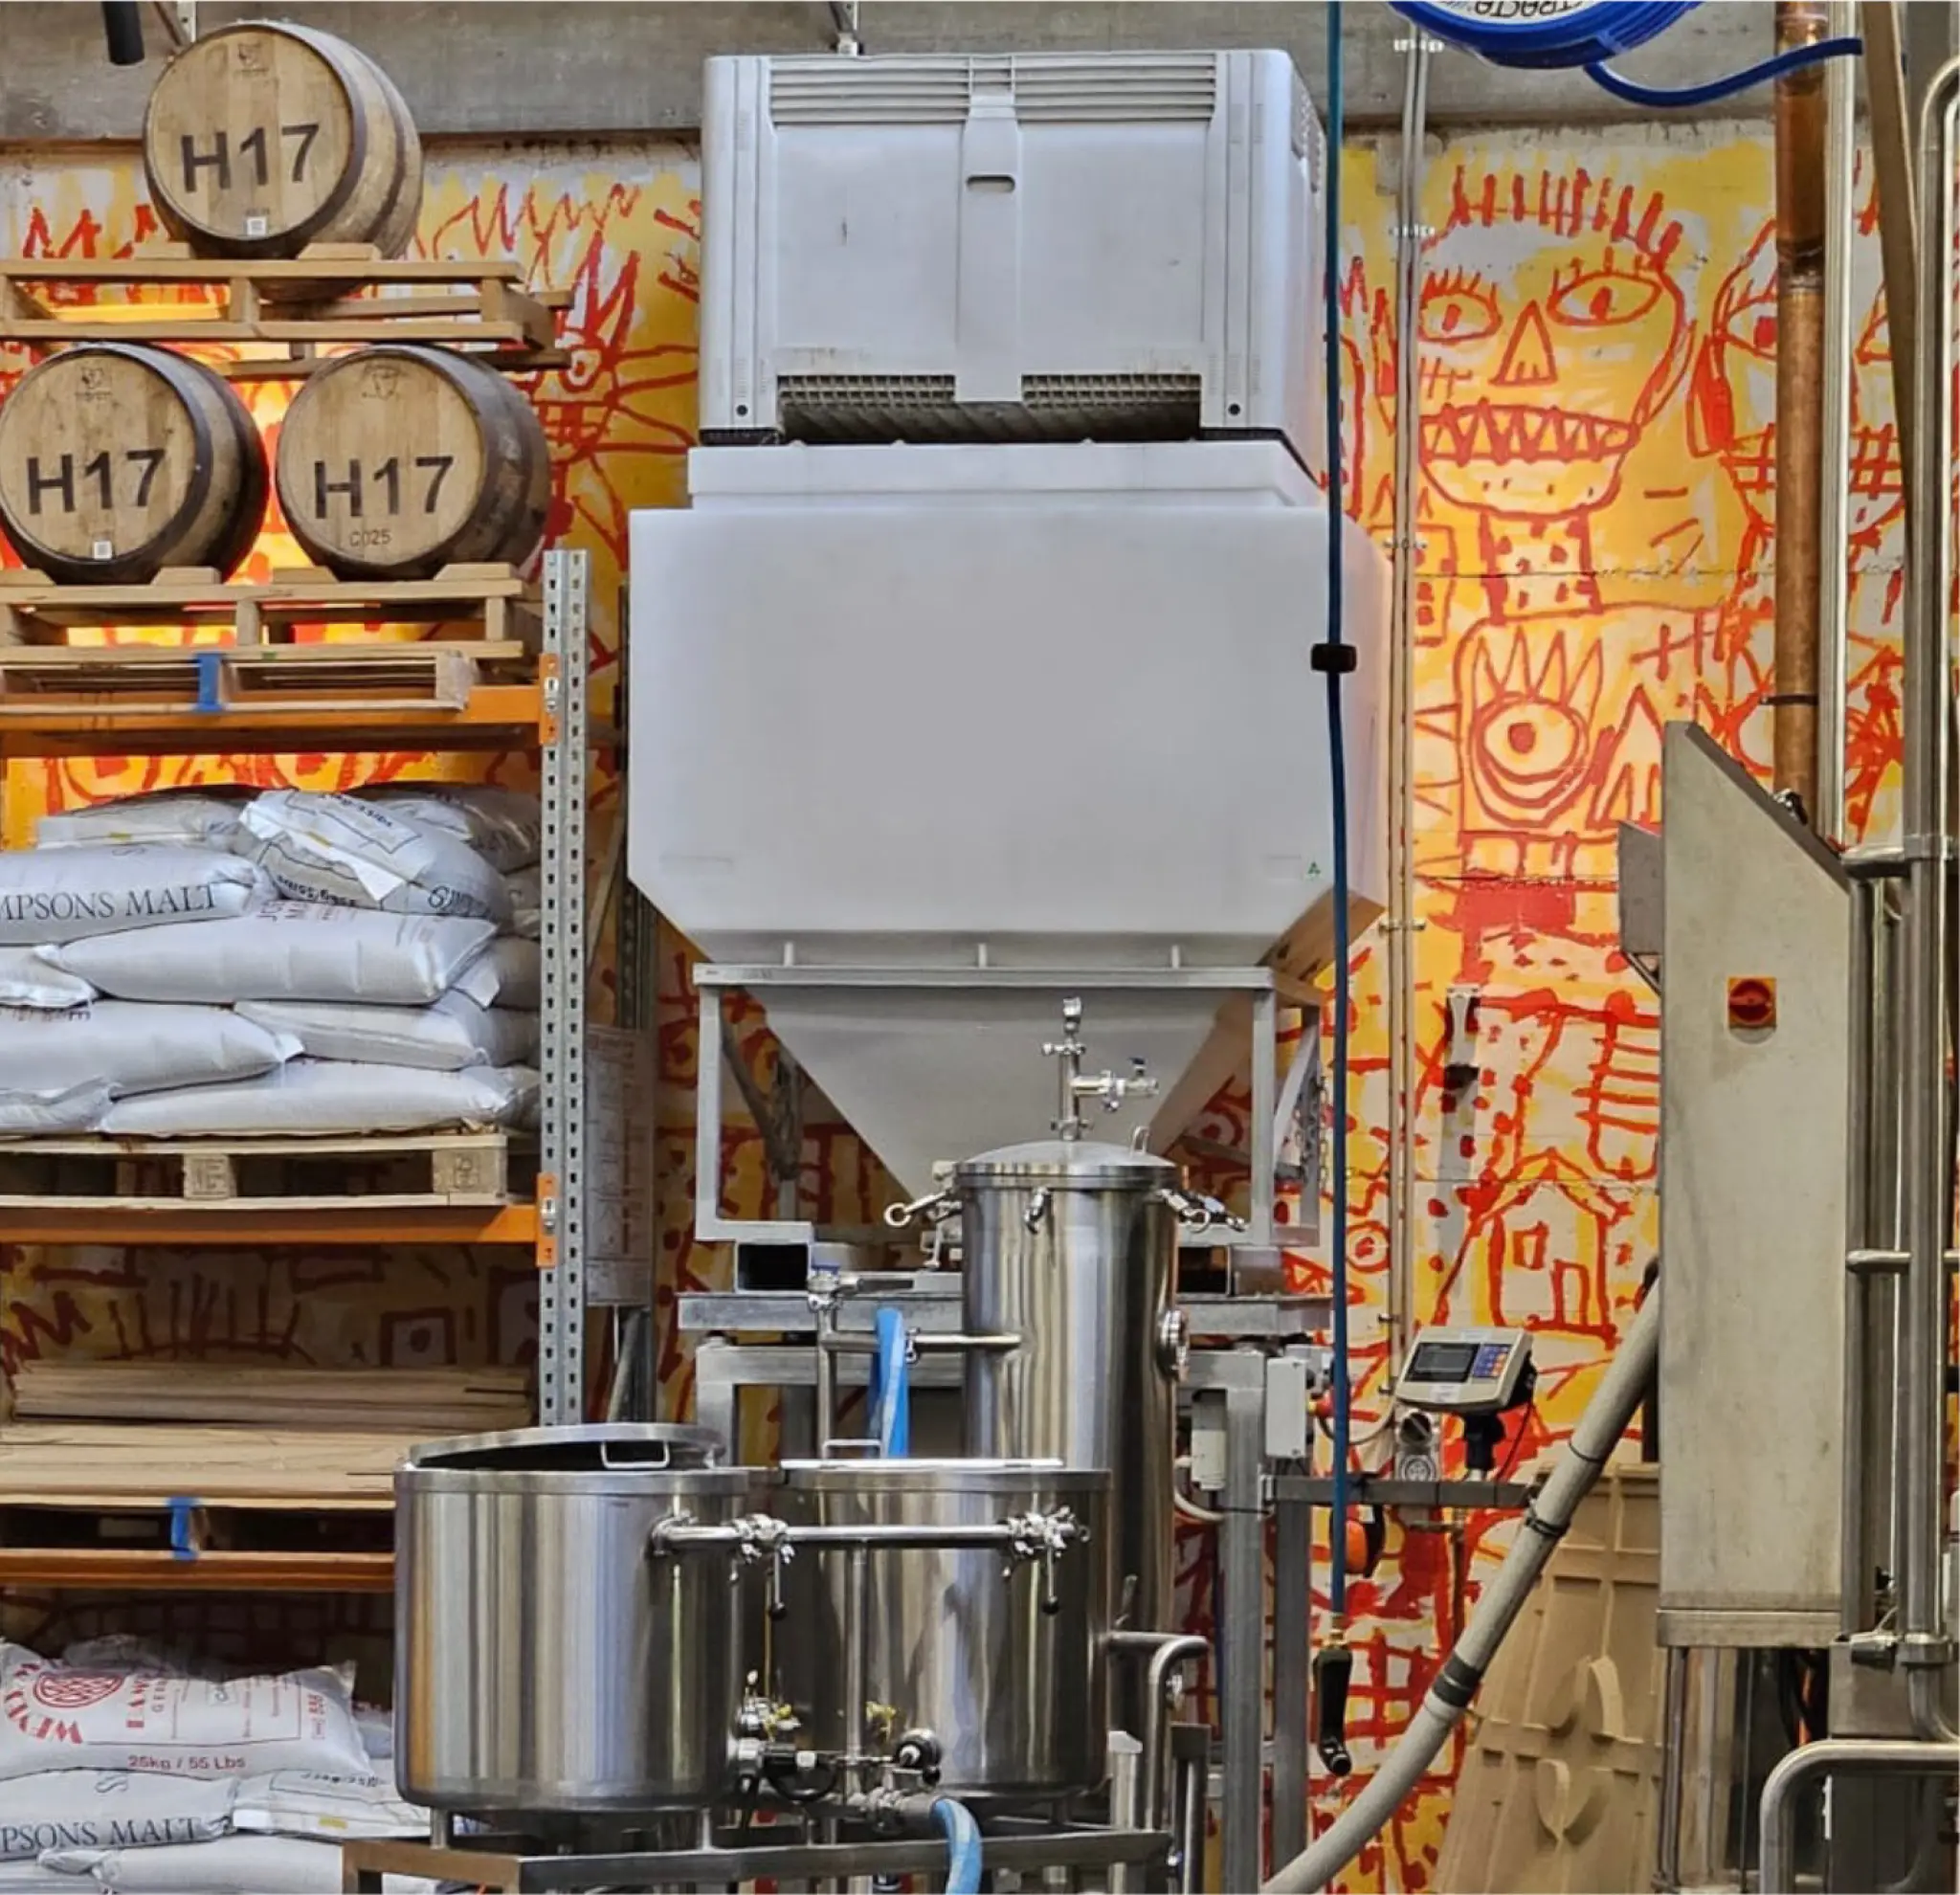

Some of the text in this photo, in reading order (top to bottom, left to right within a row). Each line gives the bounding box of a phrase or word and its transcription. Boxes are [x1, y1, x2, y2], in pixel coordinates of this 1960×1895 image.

[180, 122, 320, 193] H17
[27, 448, 166, 515] H17
[314, 456, 454, 520] H17
[125, 881, 217, 916] MALT
[127, 1754, 246, 1770] 25kg / 55 Lbs
